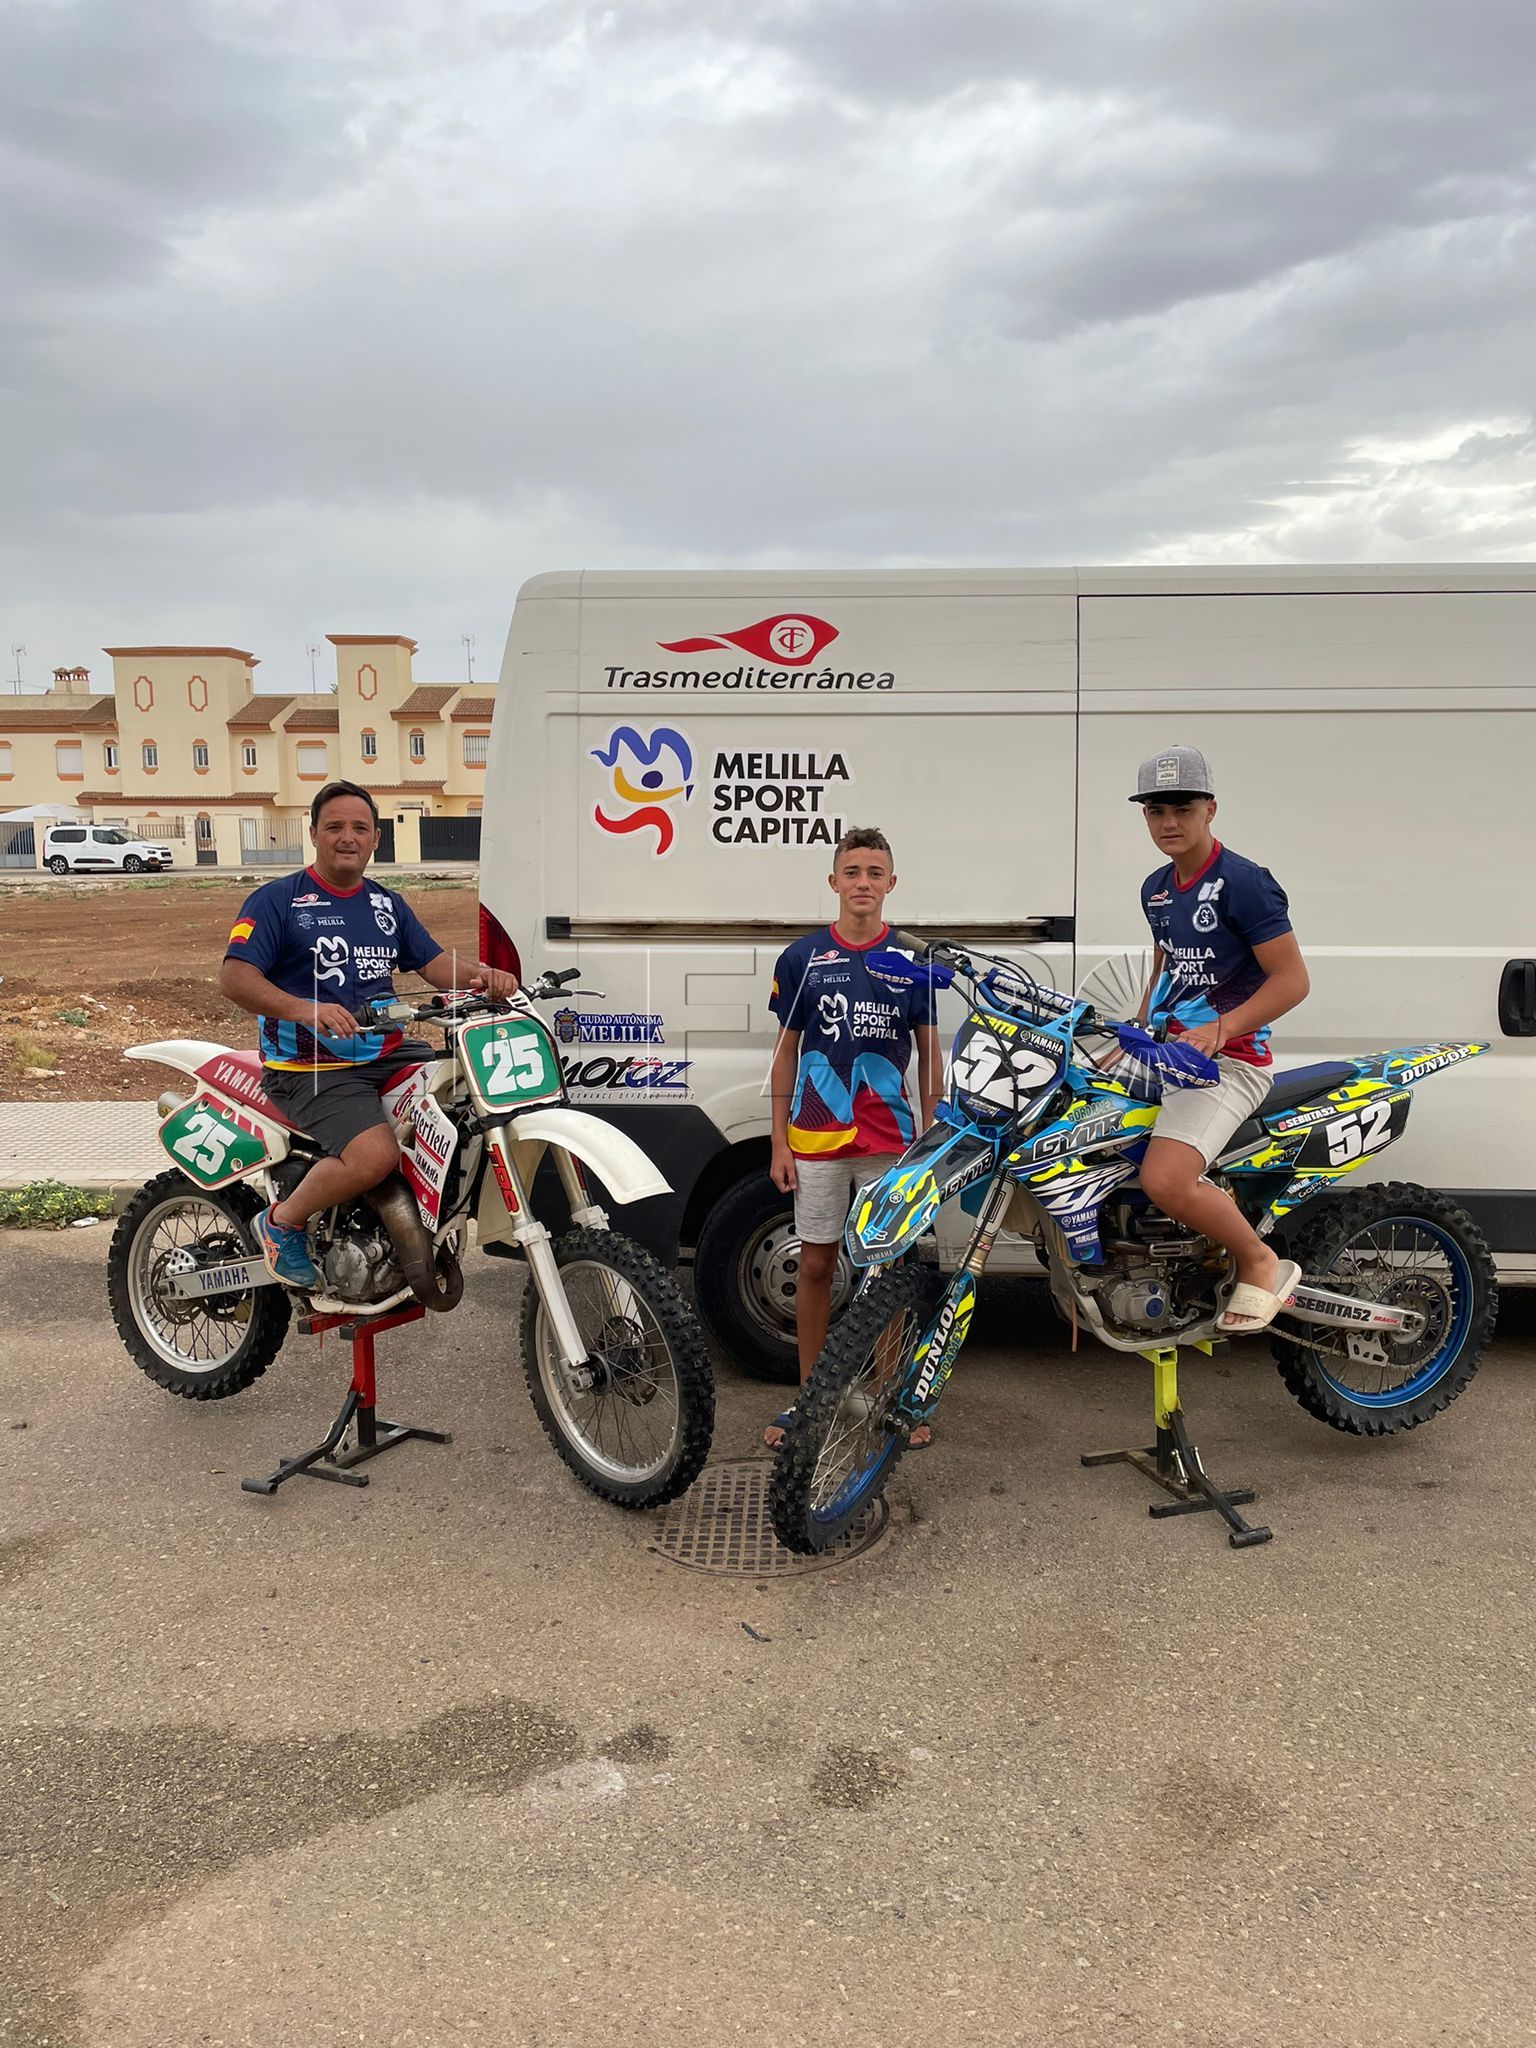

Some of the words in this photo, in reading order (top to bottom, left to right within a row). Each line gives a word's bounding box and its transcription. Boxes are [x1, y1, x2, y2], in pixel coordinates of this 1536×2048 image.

[604, 666, 895, 690] Trasmediterránea
[713, 753, 849, 780] MELILLA
[713, 785, 824, 812] SPORT
[712, 817, 845, 844] CAPITAL
[353, 946, 398, 959] MELILLA
[823, 974, 851, 984] MELILLA
[578, 1014, 612, 1024] CIUDAD
[613, 1013, 663, 1025] AUTÓNOMA
[853, 1001, 901, 1018] MELILLA
[853, 1013, 891, 1027] SPORT
[580, 1025, 664, 1043] MELILLA
[852, 1025, 899, 1040] CAPITAL
[1030, 1033, 1064, 1055] YAMAHA
[481, 1033, 546, 1096] 25
[953, 1030, 1057, 1112] 52
[1400, 1047, 1471, 1085] DUNLOP
[213, 1060, 268, 1106] YAMAHA
[1286, 1106, 1337, 1128] SEBIITA52
[172, 1113, 238, 1175] 25
[1033, 1110, 1126, 1161] GYTR
[1325, 1100, 1392, 1167] 52
[414, 1150, 439, 1186] YAMAHA
[1298, 1176, 1329, 1198] GoPro
[1071, 1208, 1097, 1224] YAMAHA
[866, 1249, 894, 1262] YAMAHA
[198, 1266, 250, 1290] YAMAHA
[1295, 1295, 1372, 1322] SEBIITA52
